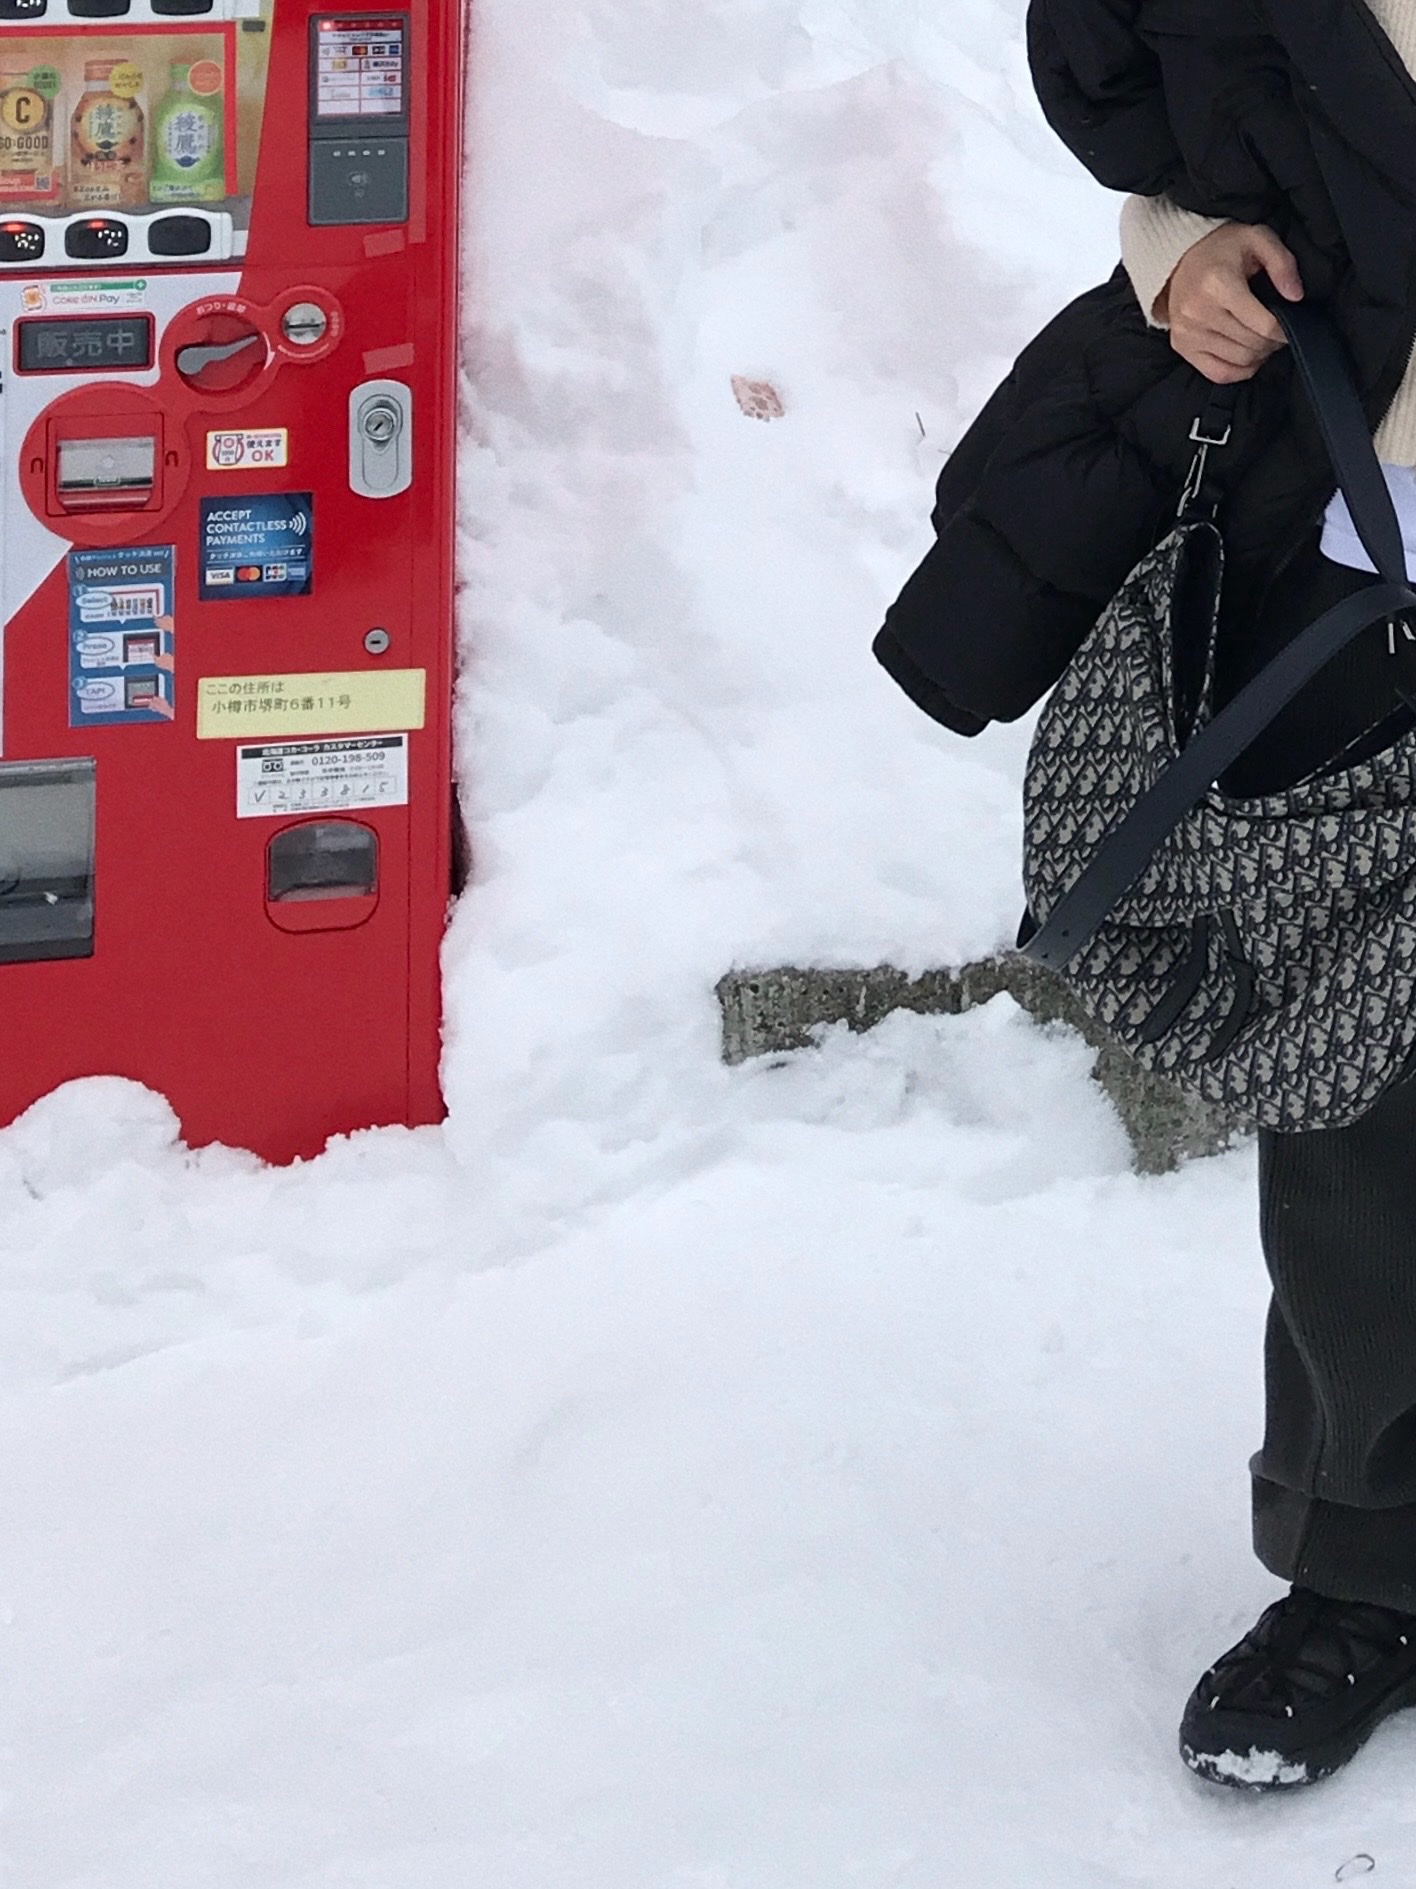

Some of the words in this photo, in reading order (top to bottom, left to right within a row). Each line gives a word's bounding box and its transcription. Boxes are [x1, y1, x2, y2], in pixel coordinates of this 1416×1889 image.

[15, 96, 31, 124] C
[53, 294, 79, 305] Coke
[100, 294, 121, 305] Pay
[37, 328, 136, 359] 販売中
[251, 450, 275, 463] OK
[206, 510, 252, 522] ACCEPT
[206, 520, 287, 534] CONTACTLESS
[206, 533, 266, 546] PAYMENTS
[87, 565, 118, 578] HOW
[120, 565, 138, 576] TO
[140, 563, 162, 575] USE
[211, 572, 231, 580] VISA
[206, 680, 284, 695] ここの住所は
[212, 694, 352, 714] 小樽市堺町6番11号
